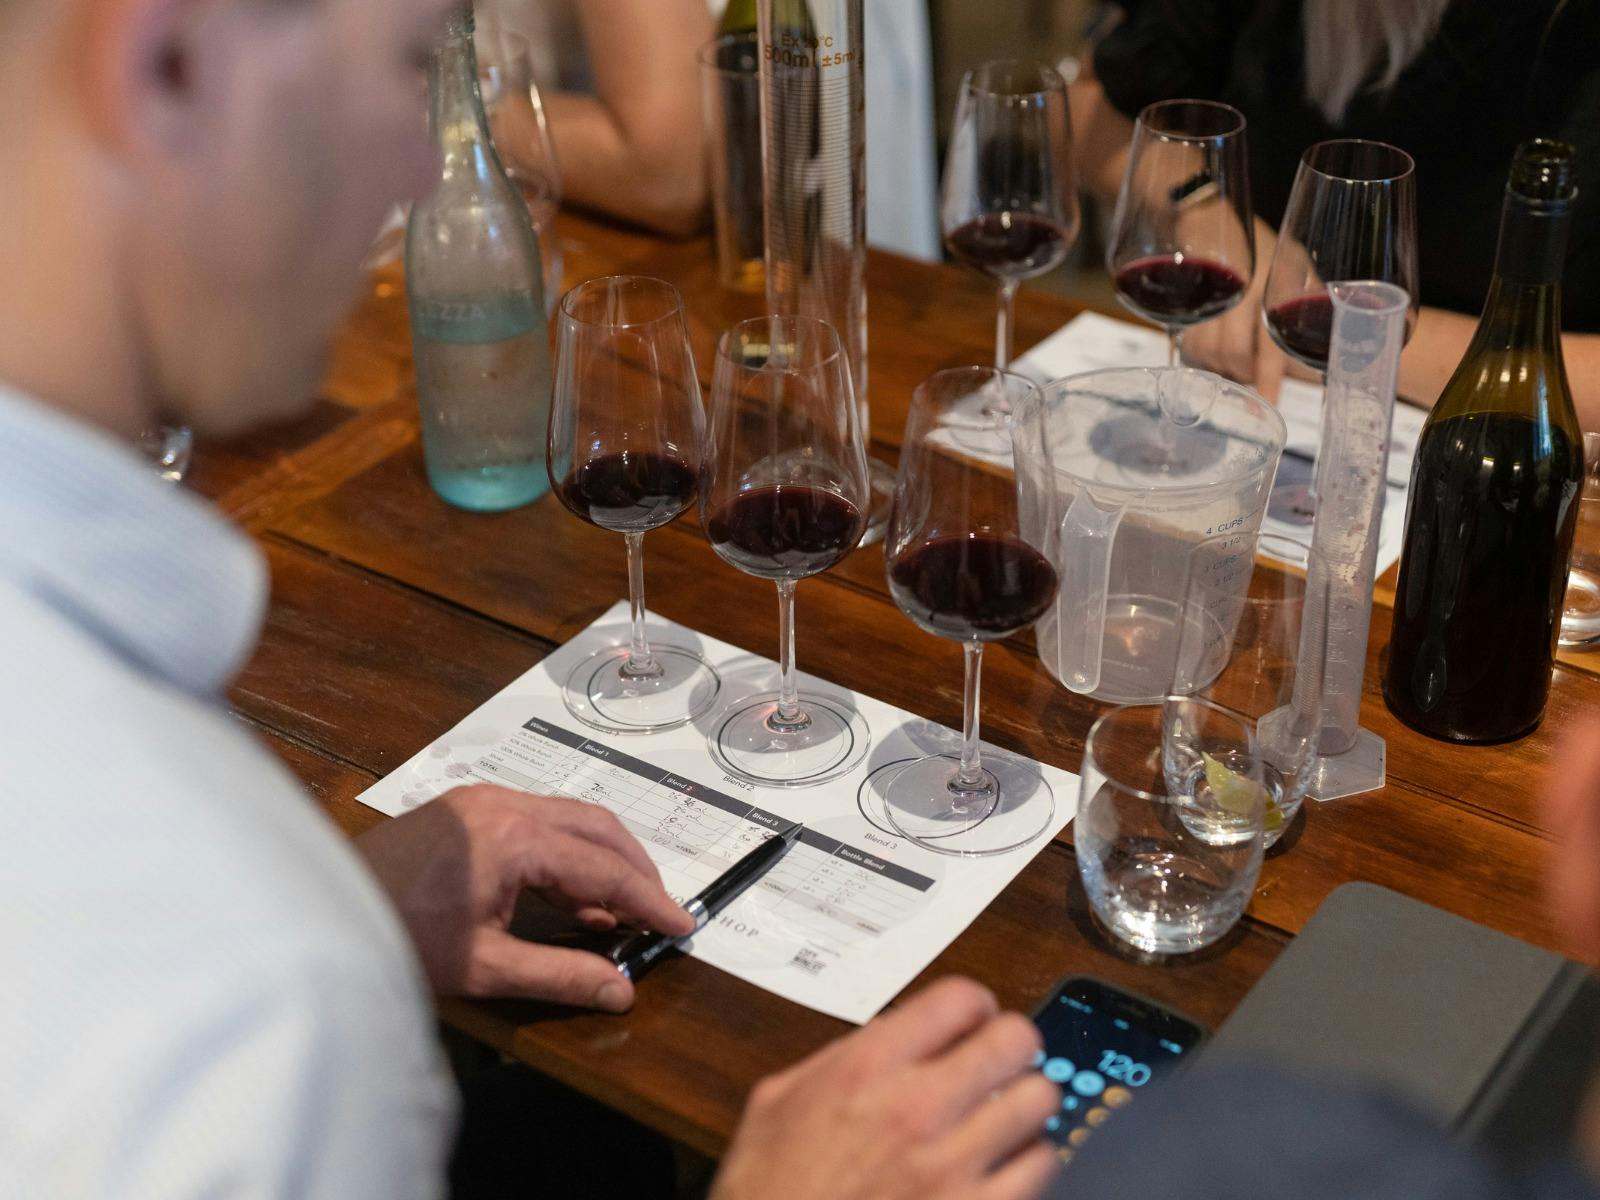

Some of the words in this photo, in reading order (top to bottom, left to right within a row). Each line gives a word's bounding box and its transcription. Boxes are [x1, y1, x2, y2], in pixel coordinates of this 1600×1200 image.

[1205, 526, 1213, 536] 4
[1217, 517, 1244, 533] CUPS
[1221, 541, 1228, 550] 3
[584, 743, 605, 755] Blend
[479, 760, 498, 772] TOTAL
[666, 777, 687, 789] Blend
[722, 775, 746, 789] Blend
[752, 812, 774, 824] Blend
[863, 832, 890, 847] Blend
[889, 842, 898, 850] 3
[1097, 1049, 1152, 1087] 120
